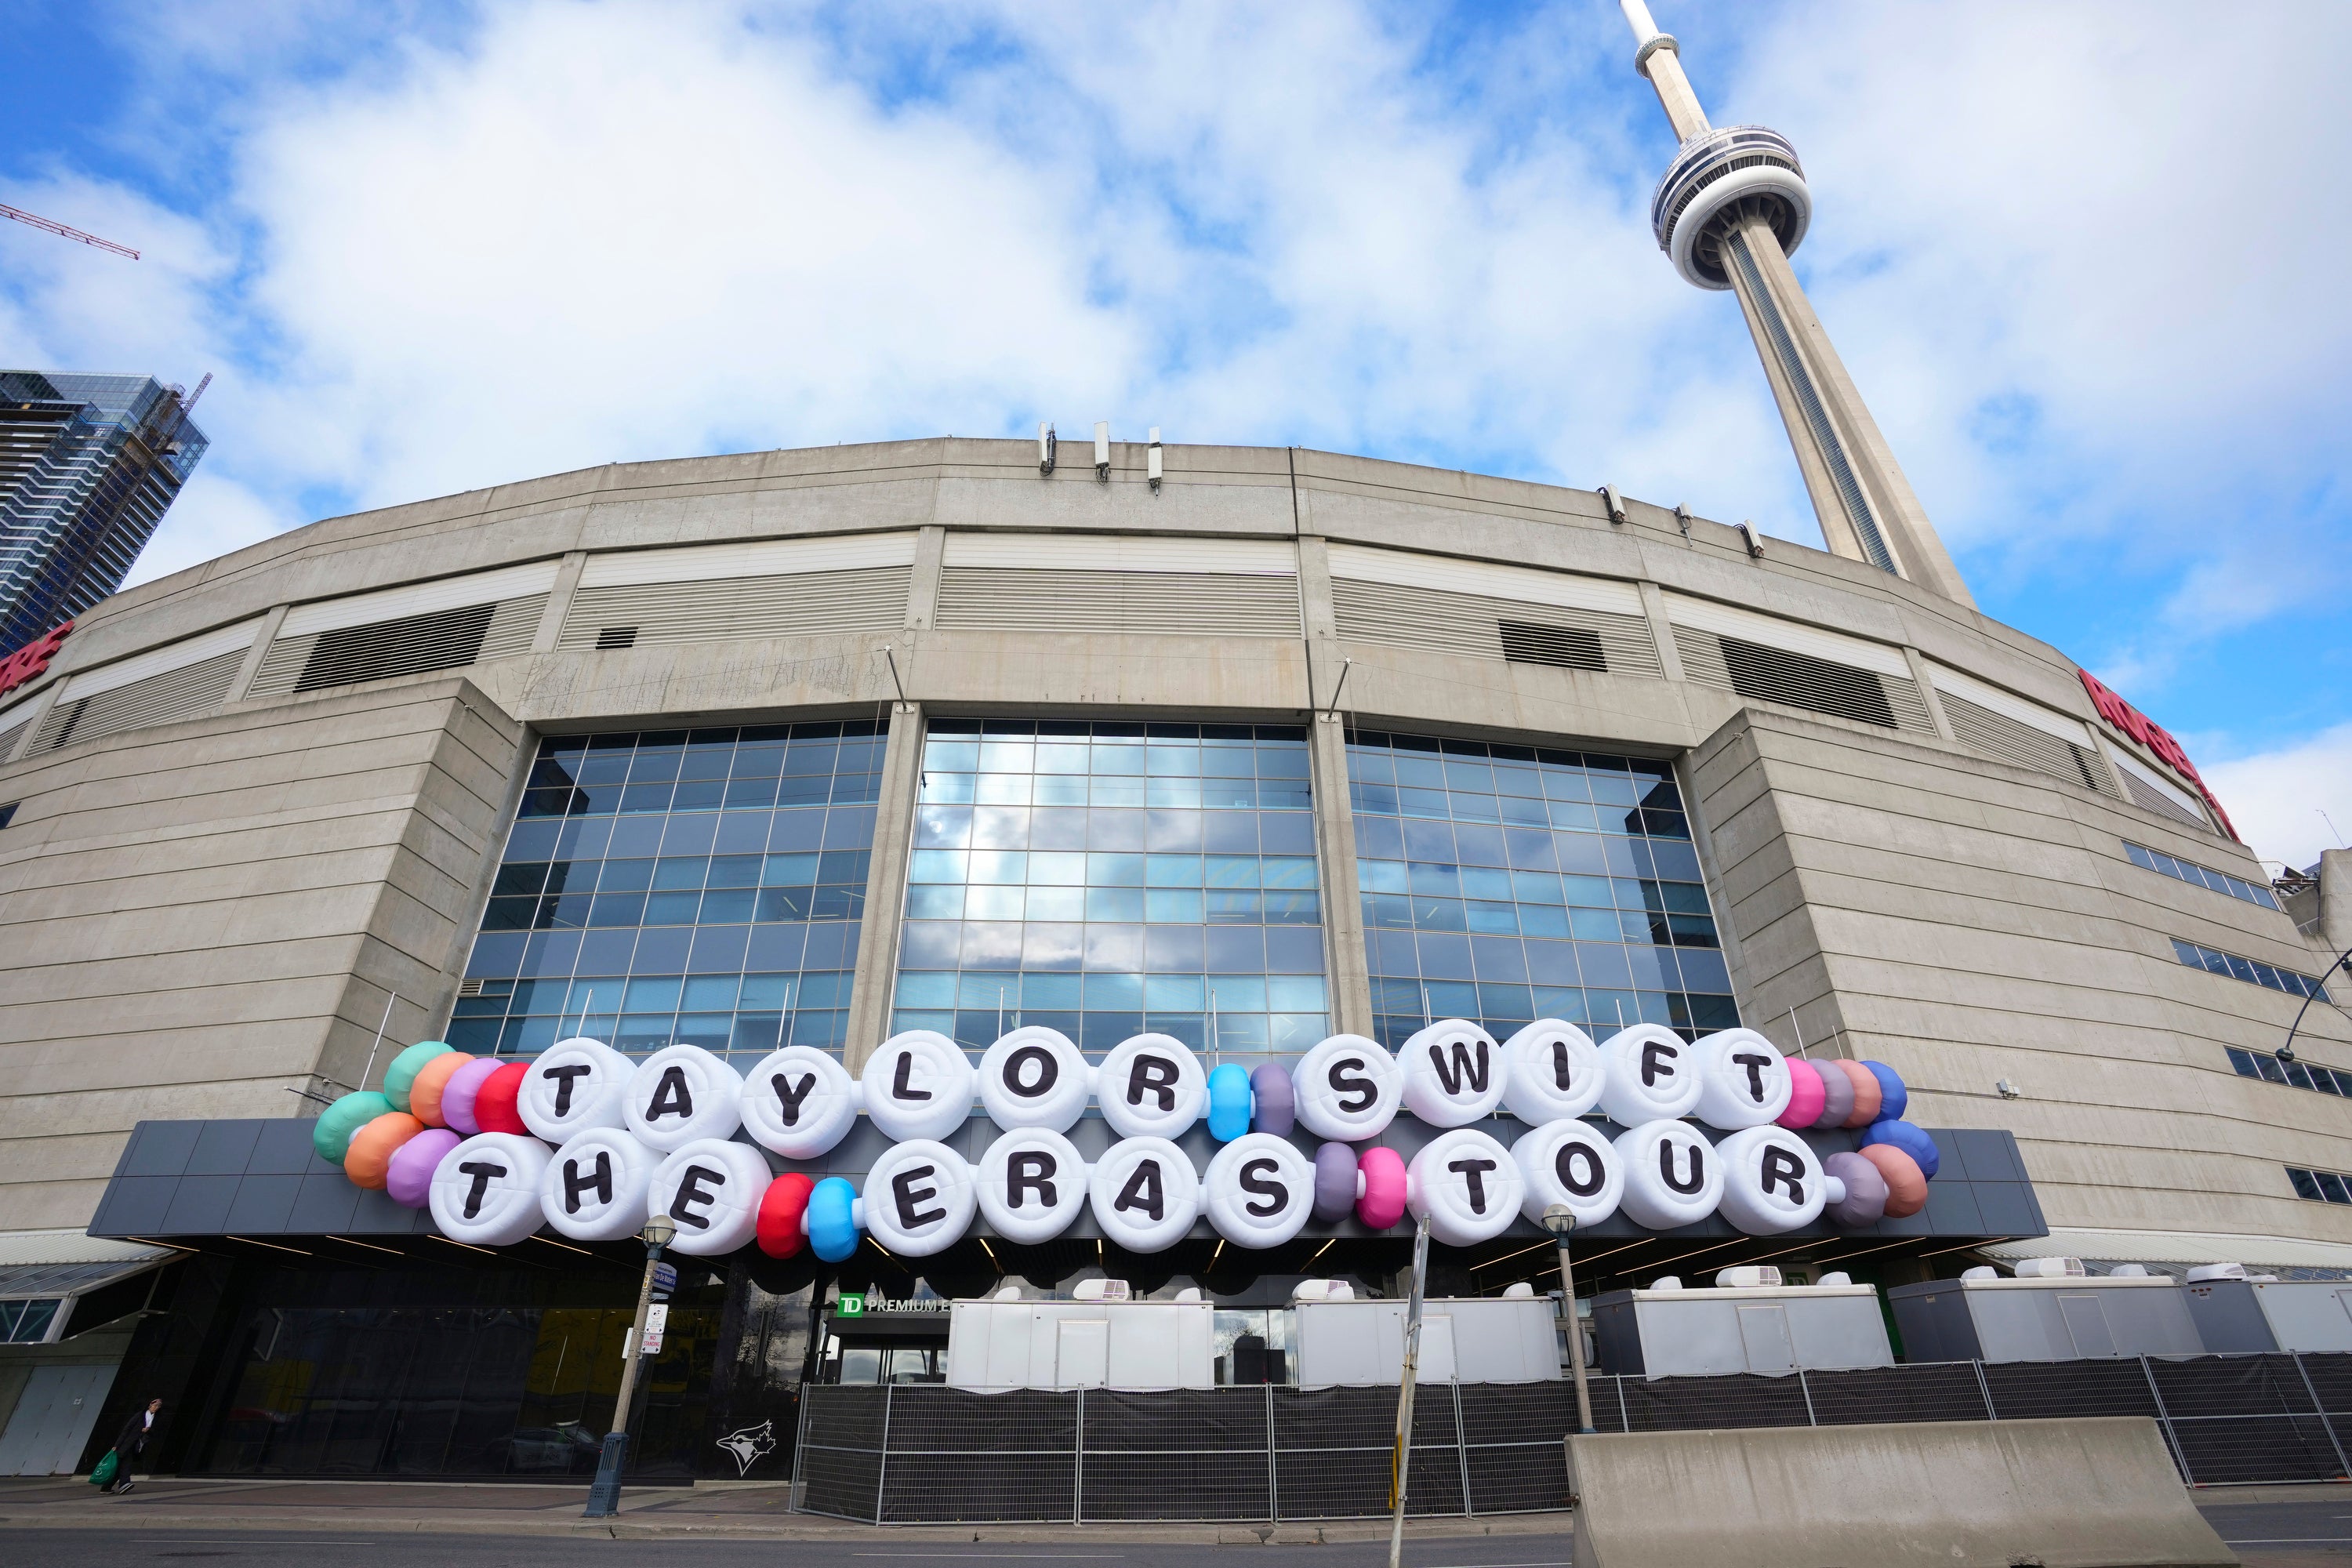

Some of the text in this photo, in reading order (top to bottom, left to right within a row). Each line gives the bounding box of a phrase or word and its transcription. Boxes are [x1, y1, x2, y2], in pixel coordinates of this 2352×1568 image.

[2078, 668, 2229, 821] ROGE
[543, 1040, 1772, 1127] TAYLOR SWIFT
[459, 1138, 1806, 1229] THE ERAS TOUR
[840, 1298, 862, 1313] TD
[868, 1299, 937, 1312] PREMIUM
